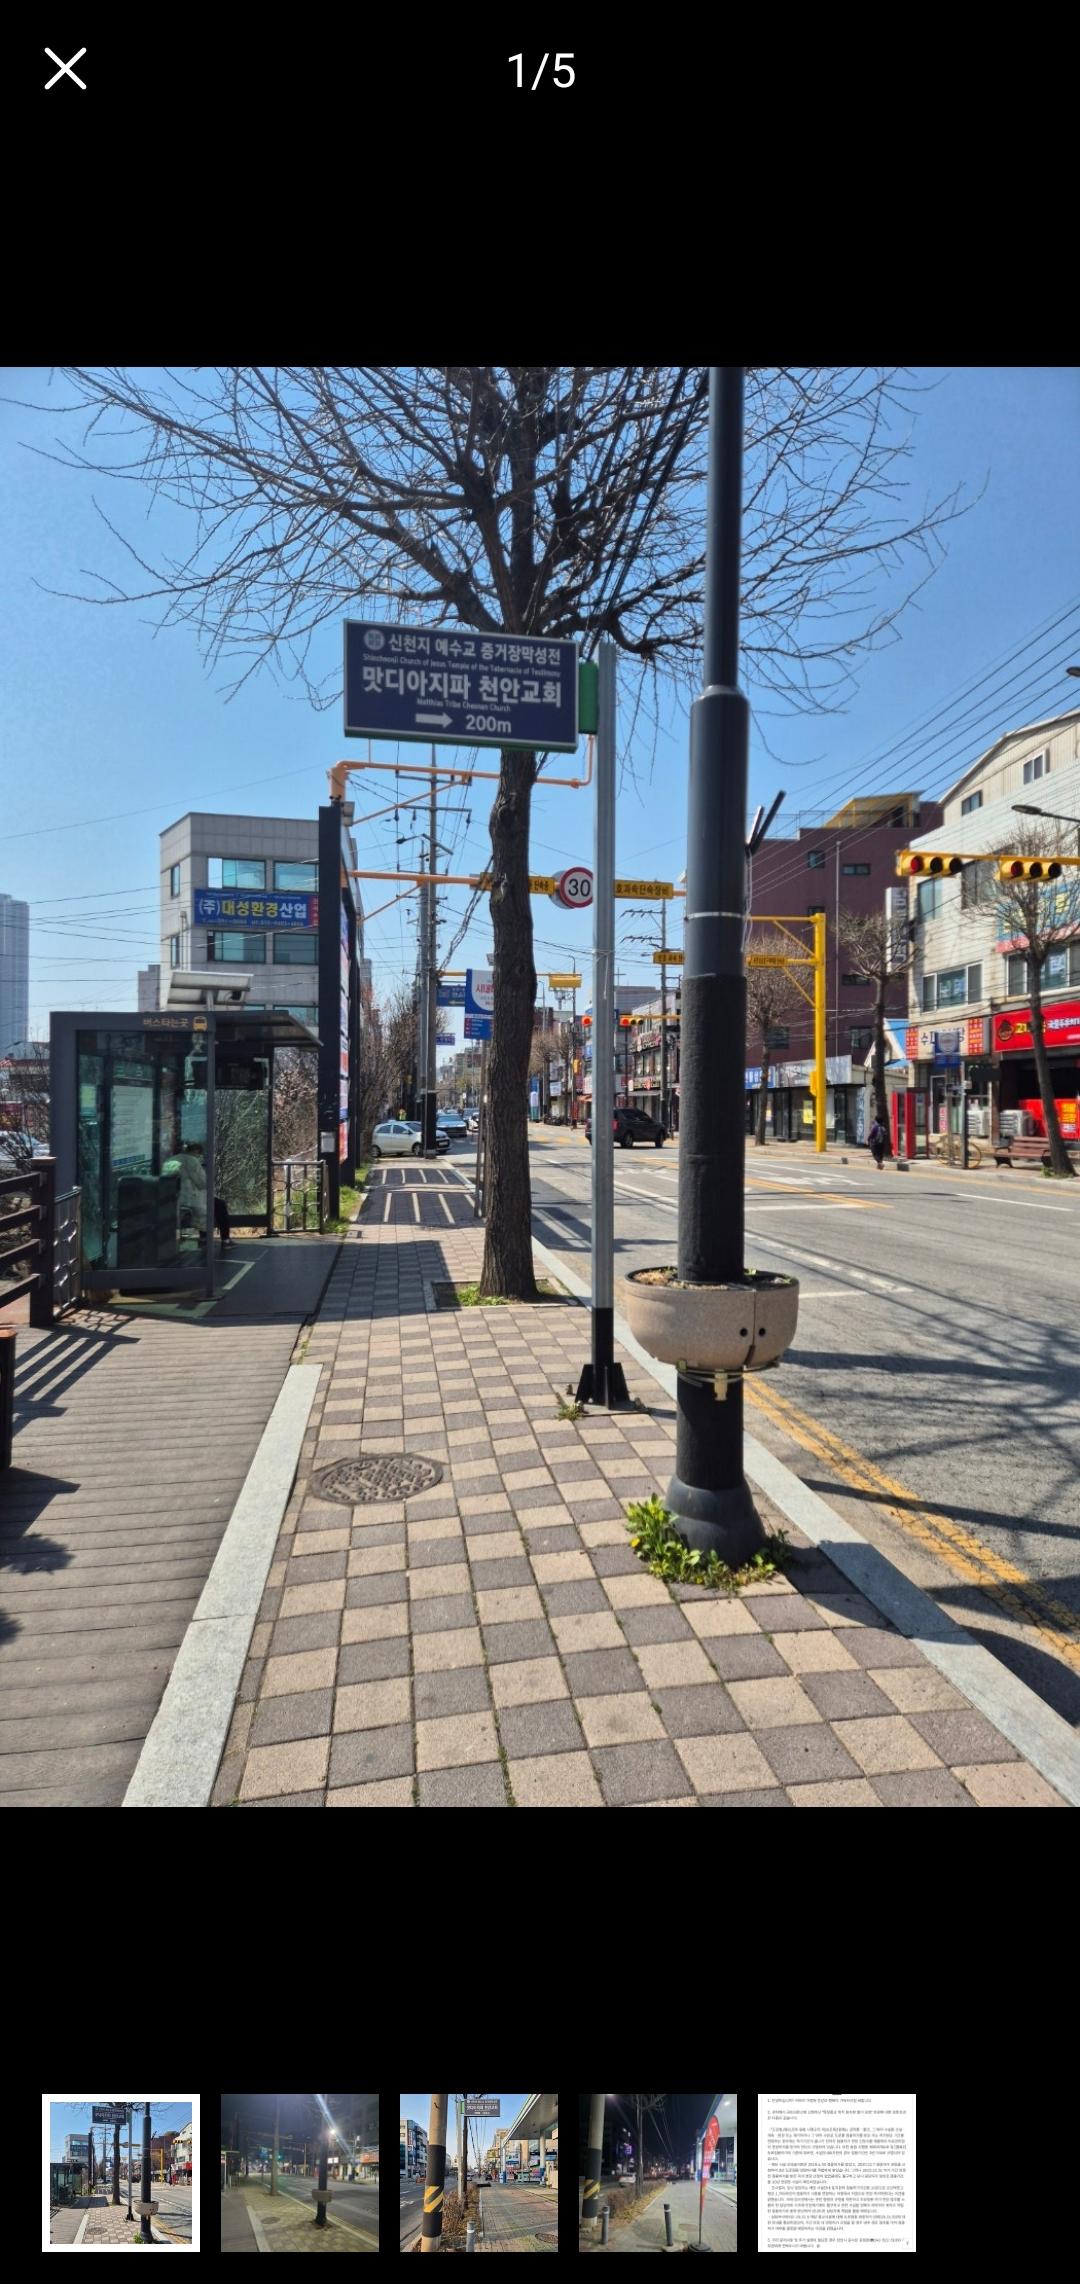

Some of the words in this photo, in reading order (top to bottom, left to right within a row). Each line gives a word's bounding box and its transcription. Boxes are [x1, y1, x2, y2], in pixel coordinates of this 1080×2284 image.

[388, 633, 431, 655] 신천지
[435, 639, 476, 657] 예수교
[480, 643, 561, 666] 증거장막성전
[362, 666, 471, 700] 맛디아지파
[479, 675, 562, 708] 천안교회
[465, 714, 512, 734] 200m
[568, 878, 591, 897] 30
[615, 882, 669, 897] 호과속단속장비
[199, 897, 307, 919] (주)대성환경산업
